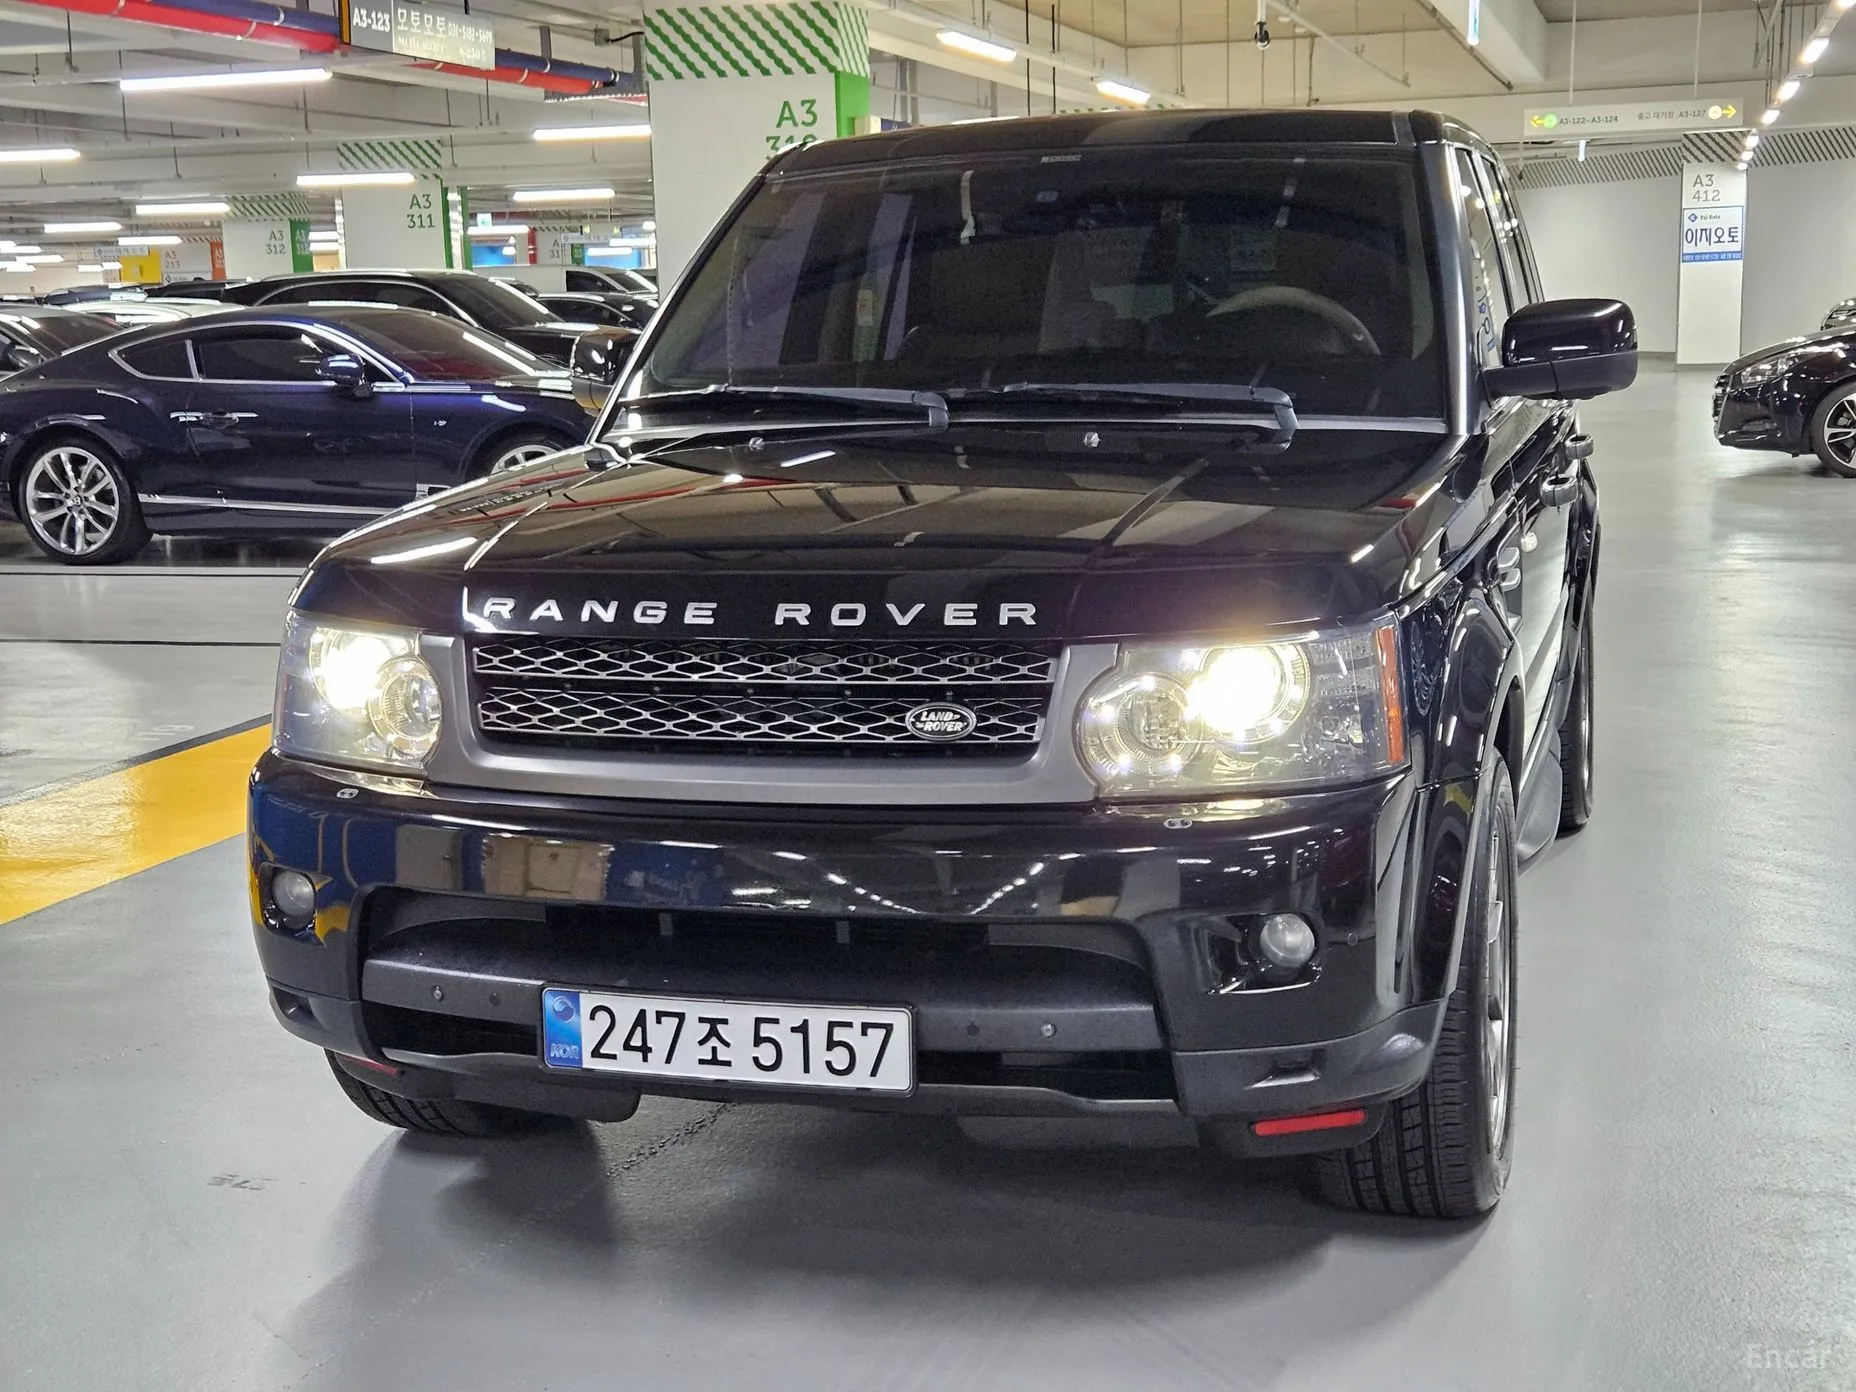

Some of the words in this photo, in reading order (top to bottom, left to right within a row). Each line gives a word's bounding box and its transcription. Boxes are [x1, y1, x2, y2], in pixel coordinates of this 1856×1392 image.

[353, 7, 391, 32] A3-123
[397, 8, 447, 38] 모토모토
[776, 99, 818, 128] A3
[1693, 174, 1714, 188] A3
[409, 193, 432, 210] A3
[1692, 189, 1720, 202] 412
[406, 213, 436, 229] 311
[269, 230, 284, 241] A3
[1685, 226, 1739, 247] 이지오토
[265, 244, 286, 255] 312
[483, 597, 718, 624] RANGE
[775, 603, 1037, 625] ROVER
[920, 711, 954, 721] LAND
[923, 721, 963, 732] ROVER
[589, 1005, 732, 1067] 247조
[752, 1017, 894, 1077] 5157
[550, 1043, 580, 1060] KOR
